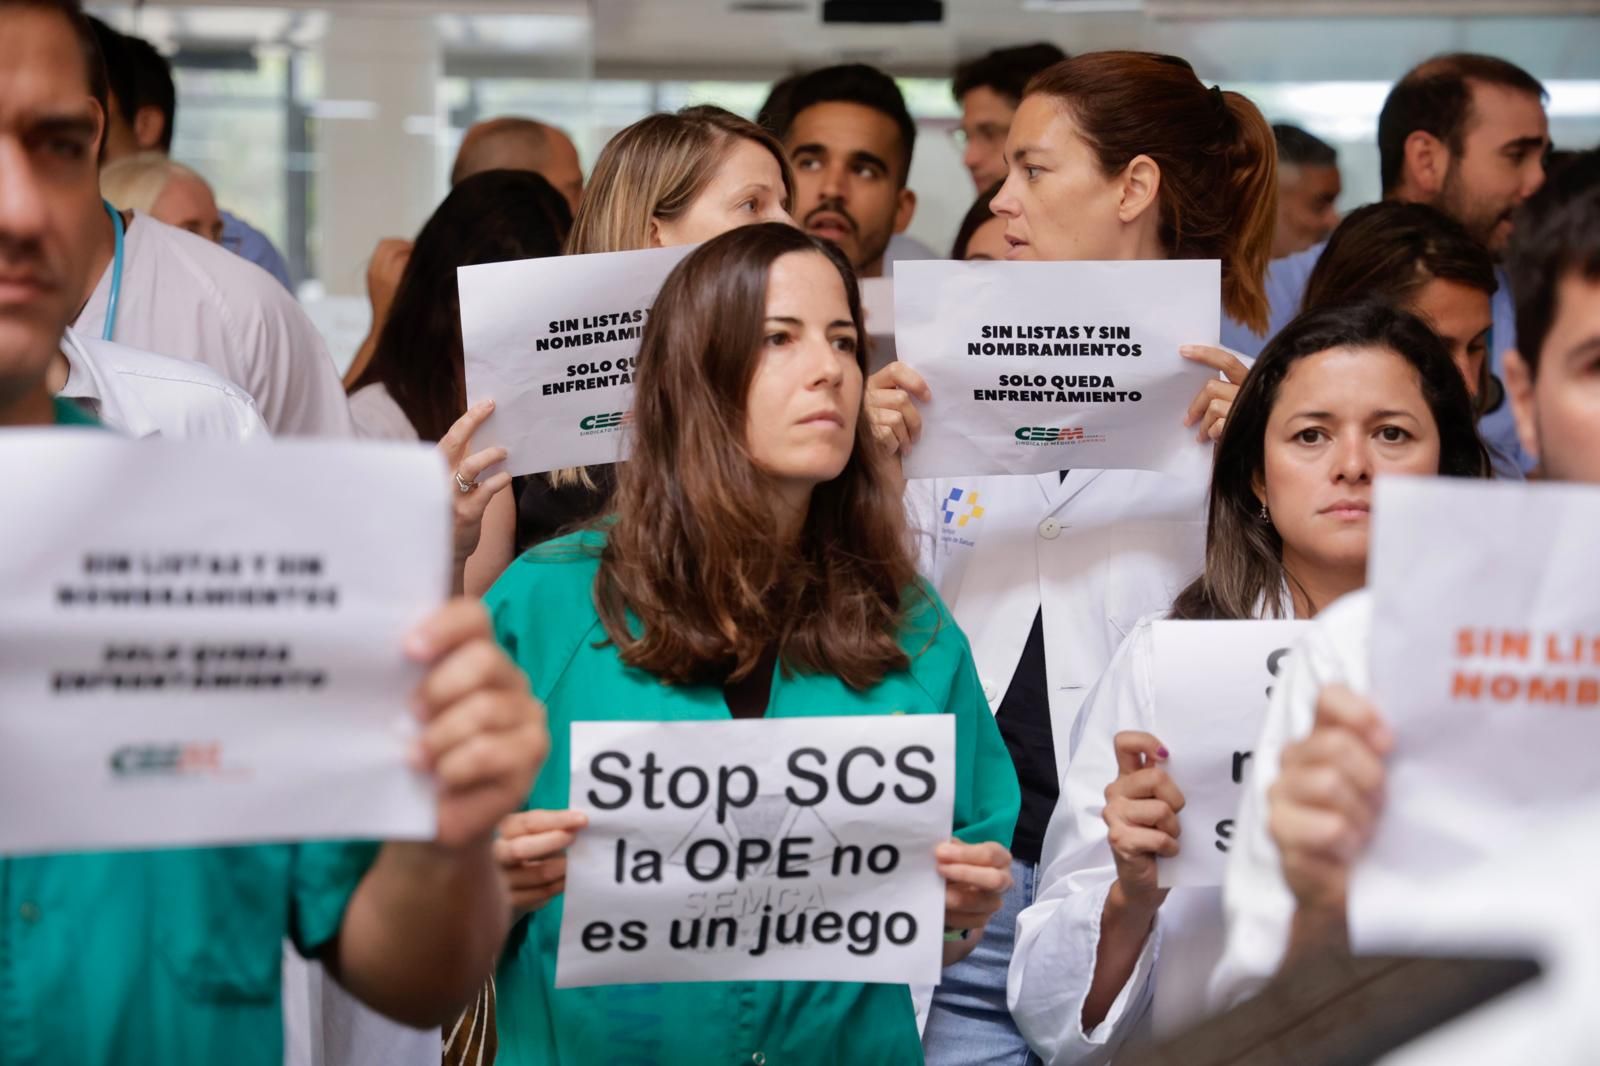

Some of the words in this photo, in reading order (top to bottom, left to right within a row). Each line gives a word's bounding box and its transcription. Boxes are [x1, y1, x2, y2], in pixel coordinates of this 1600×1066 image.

[549, 318, 579, 334] SIN
[583, 309, 642, 330] LISTAS
[536, 327, 647, 351] NOMBRAMI
[981, 325, 1013, 339] SIN
[1017, 325, 1080, 340] LISTAS
[1083, 325, 1096, 339] Y
[1099, 325, 1131, 340] SIN
[967, 342, 1142, 358] NOMBRAMIENTOS
[567, 360, 612, 377] SOLO
[999, 374, 1048, 388] SOLO
[1051, 374, 1115, 390] QUEDA
[973, 389, 1142, 403] ENFRENTAMIENTO
[1014, 426, 1084, 441] CESM
[1454, 627, 1530, 660] SIN
[587, 751, 759, 824] Stop
[785, 745, 937, 806] SCS
[615, 838, 663, 884] la
[685, 837, 814, 882] OPE
[831, 843, 900, 877] no
[581, 920, 648, 952] es
[669, 917, 739, 949] un
[748, 905, 918, 956] juego
